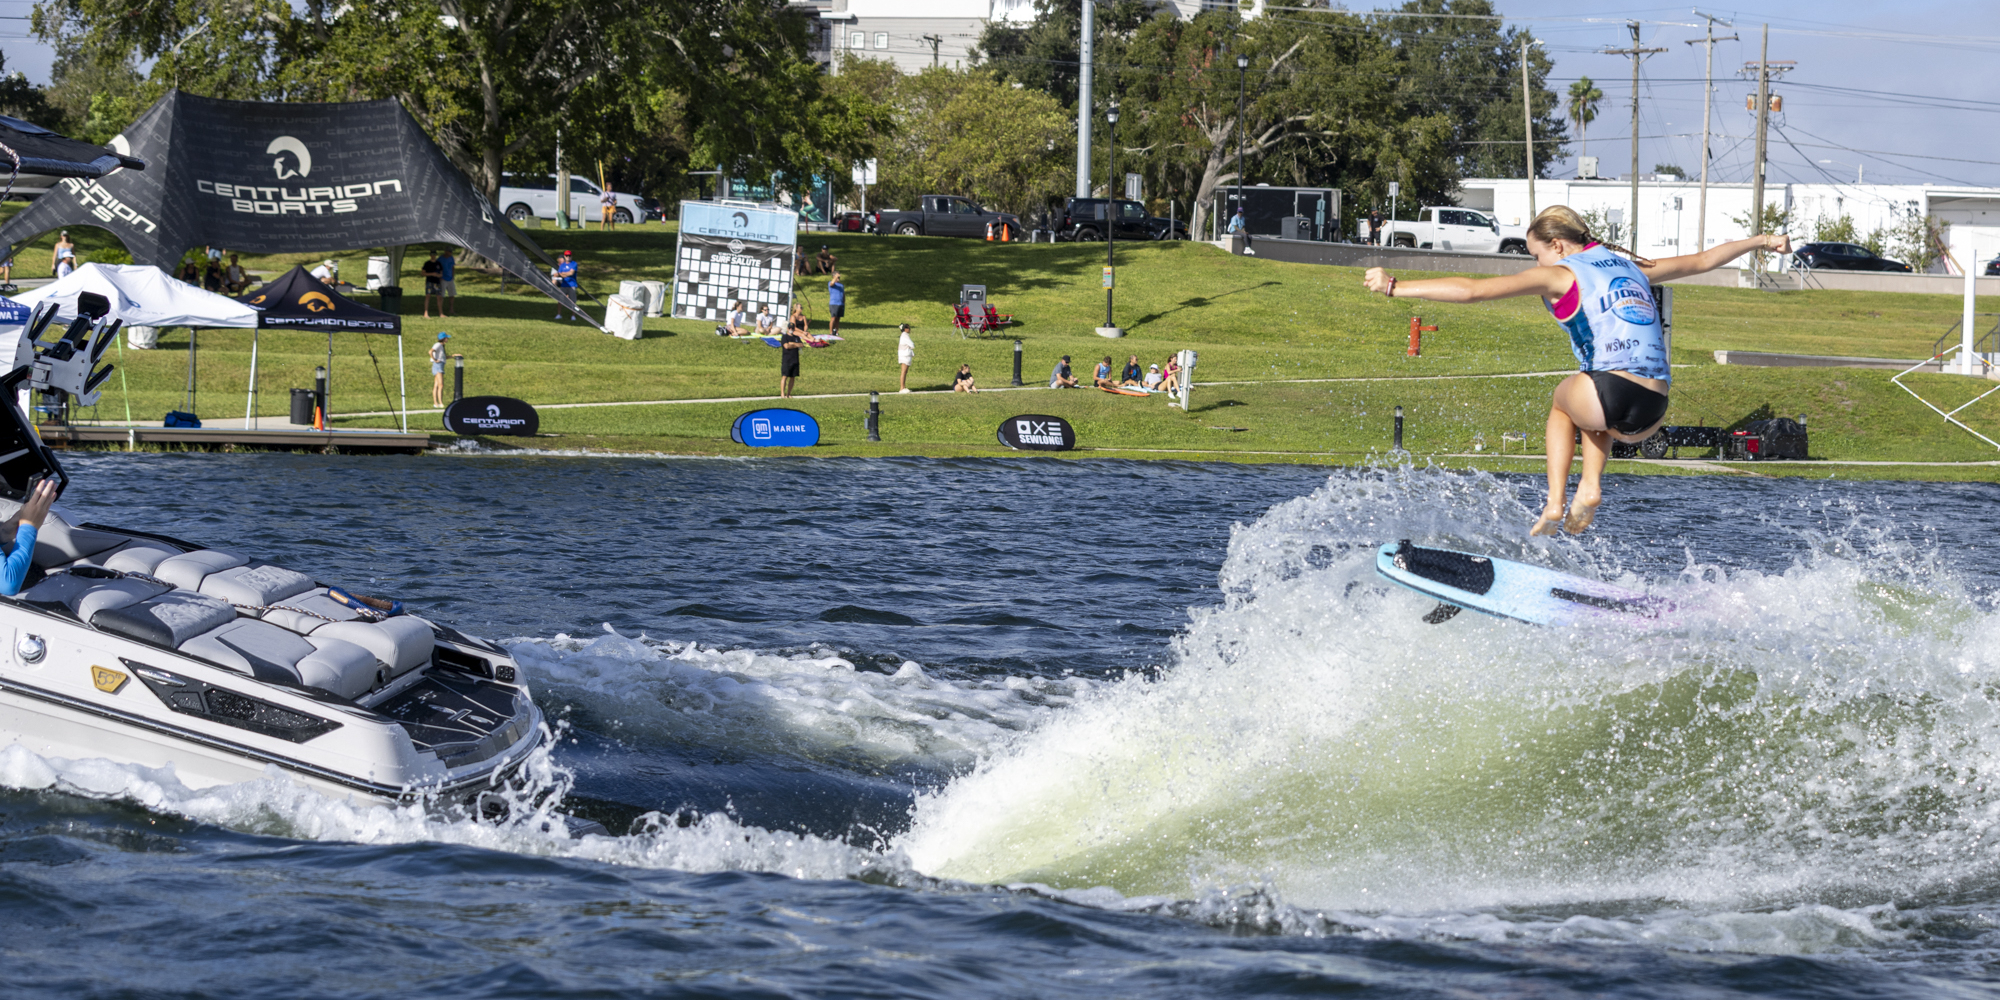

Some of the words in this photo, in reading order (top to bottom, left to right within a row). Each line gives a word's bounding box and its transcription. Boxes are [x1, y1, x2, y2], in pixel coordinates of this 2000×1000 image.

[197, 179, 402, 201] CENTURION
[231, 199, 358, 215] BOATS
[699, 227, 778, 241] CENTURION
[710, 254, 729, 264] SURF
[730, 256, 761, 267] SALUTE
[1591, 258, 1630, 269] HICKEY
[265, 317, 346, 326] CENTURION
[347, 320, 394, 329] BOATS
[462, 417, 526, 425] CENTURION
[755, 423, 768, 435] gm
